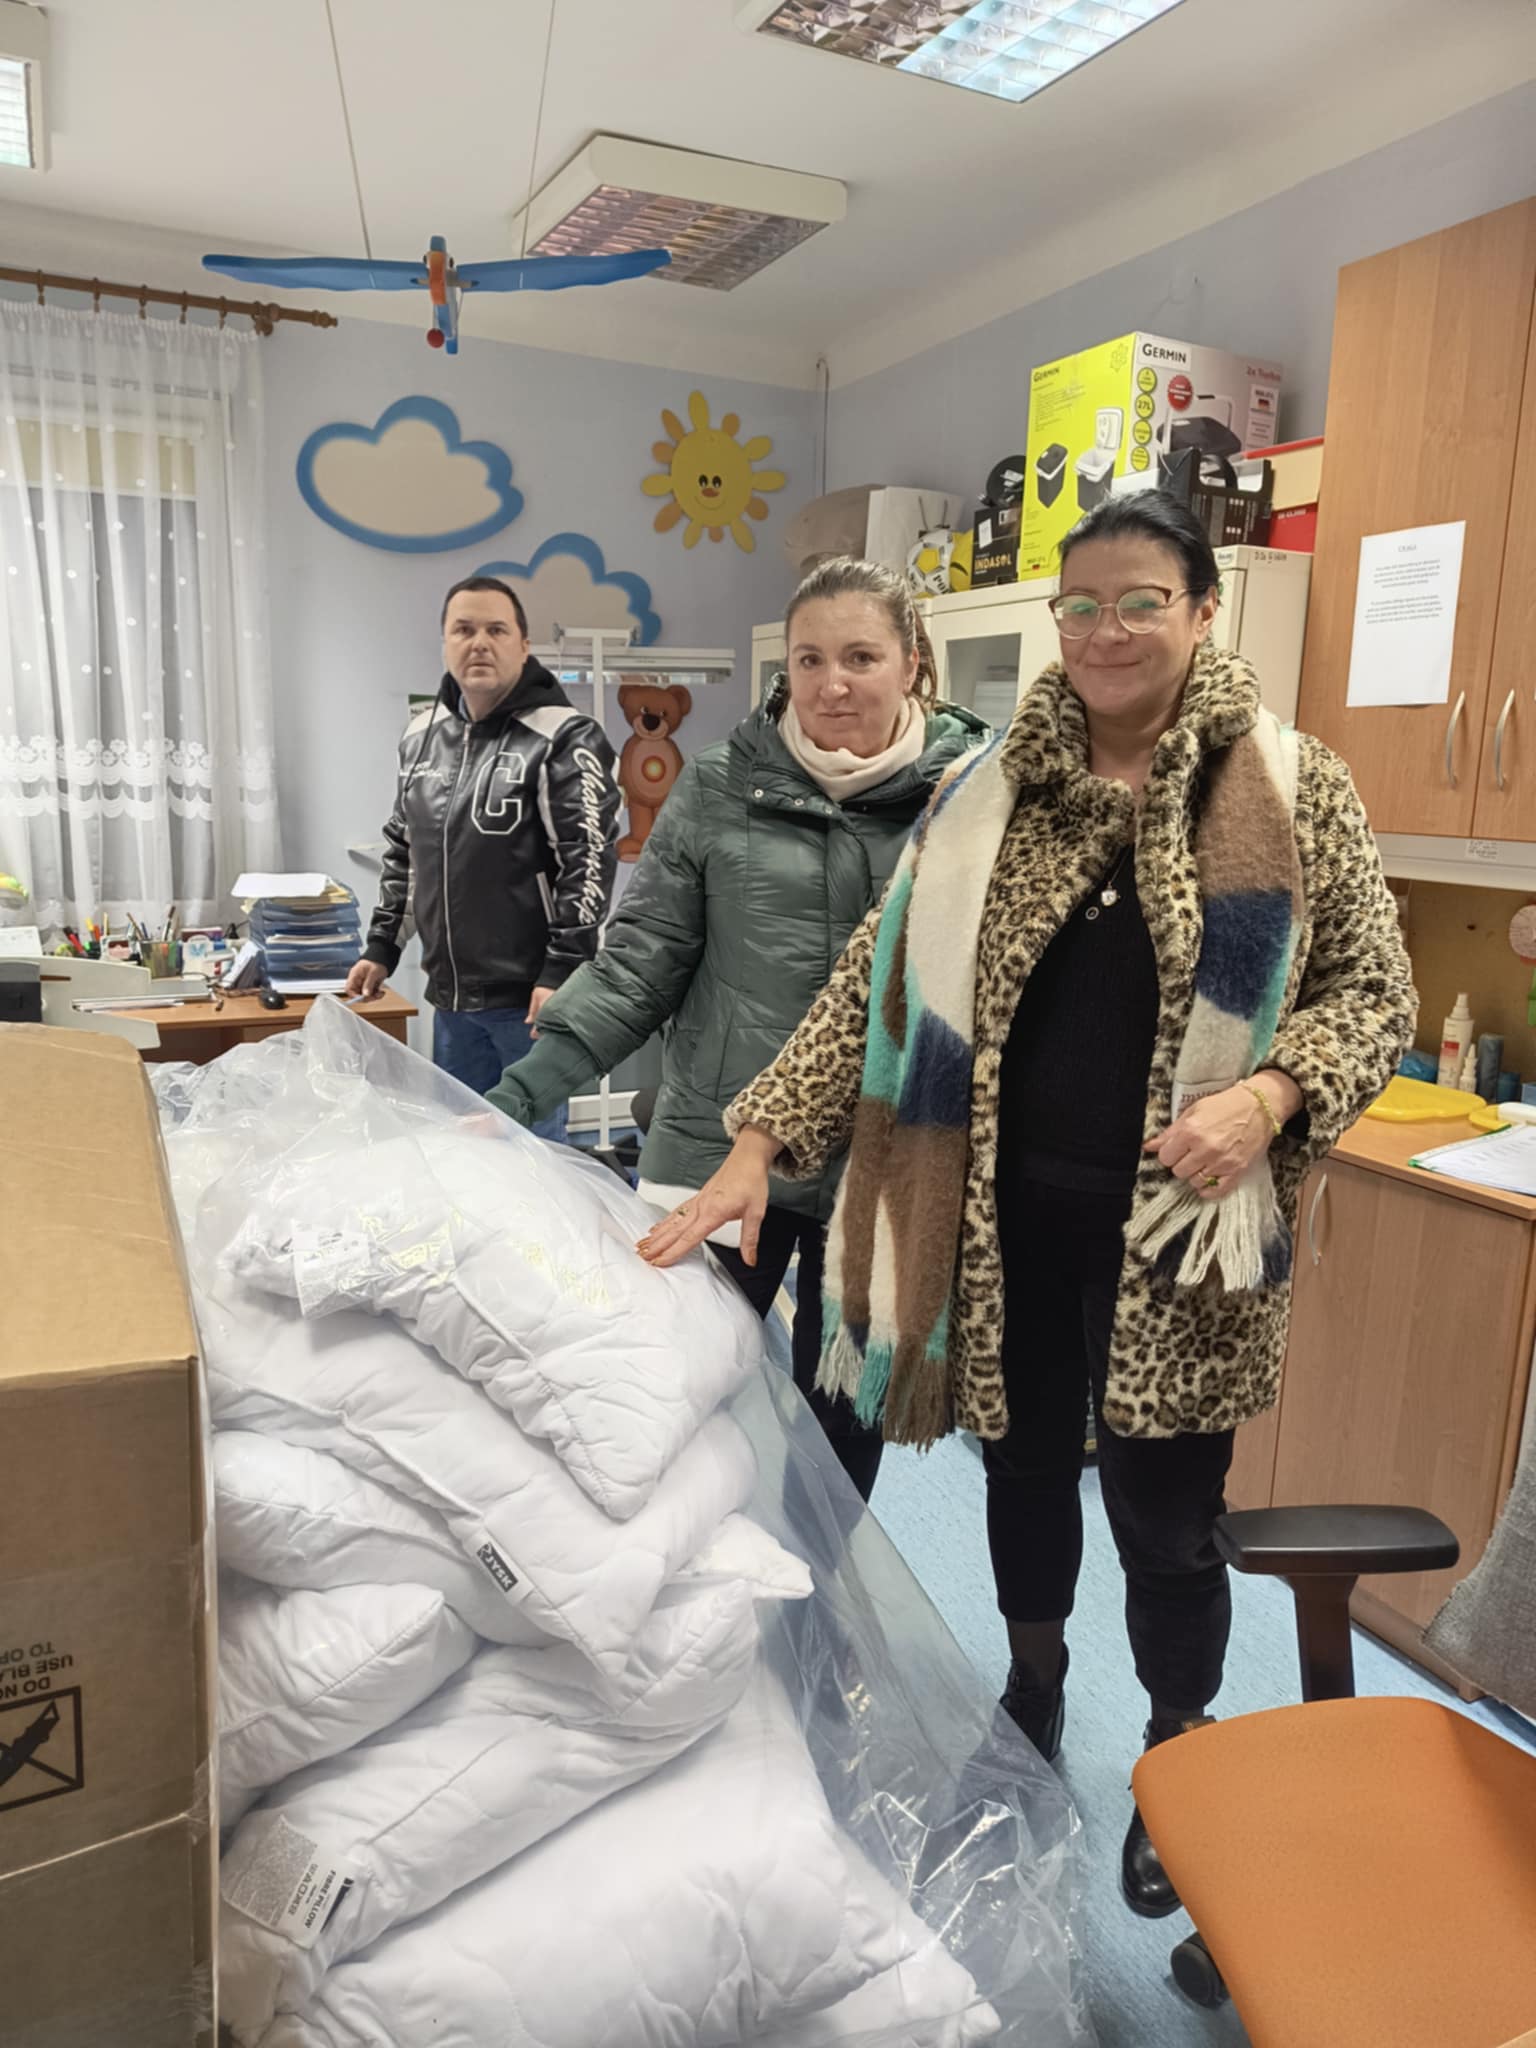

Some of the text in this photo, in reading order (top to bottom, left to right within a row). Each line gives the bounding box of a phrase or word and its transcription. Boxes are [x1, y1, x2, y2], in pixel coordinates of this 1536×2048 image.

[1143, 343, 1186, 363] GERMIN
[471, 751, 527, 835] C
[485, 1555, 513, 1588] JYSK
[30, 1641, 56, 1657] TO
[36, 1654, 73, 1674] USE
[0, 1676, 50, 1699] DO N
